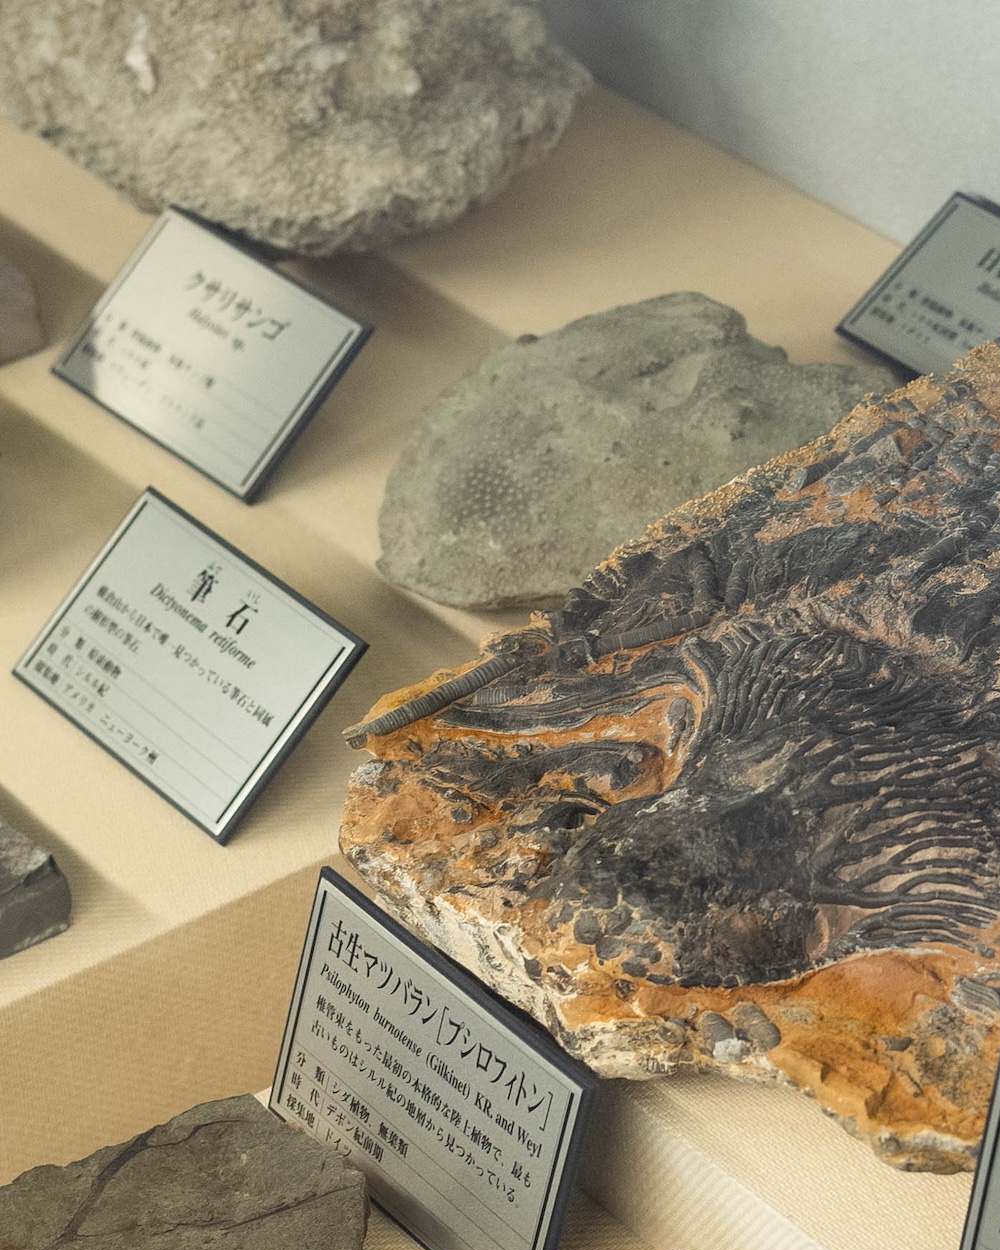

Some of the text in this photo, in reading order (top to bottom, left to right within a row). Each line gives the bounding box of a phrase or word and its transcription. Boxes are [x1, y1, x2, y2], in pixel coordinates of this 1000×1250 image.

[208, 631, 256, 669] retiforme
[320, 963, 543, 1159] Psilophyton burnotense (Gilkinet) KR. and Weyl
[326, 1104, 384, 1163] デボン紀前期
[326, 1128, 352, 1157] ドイツ
